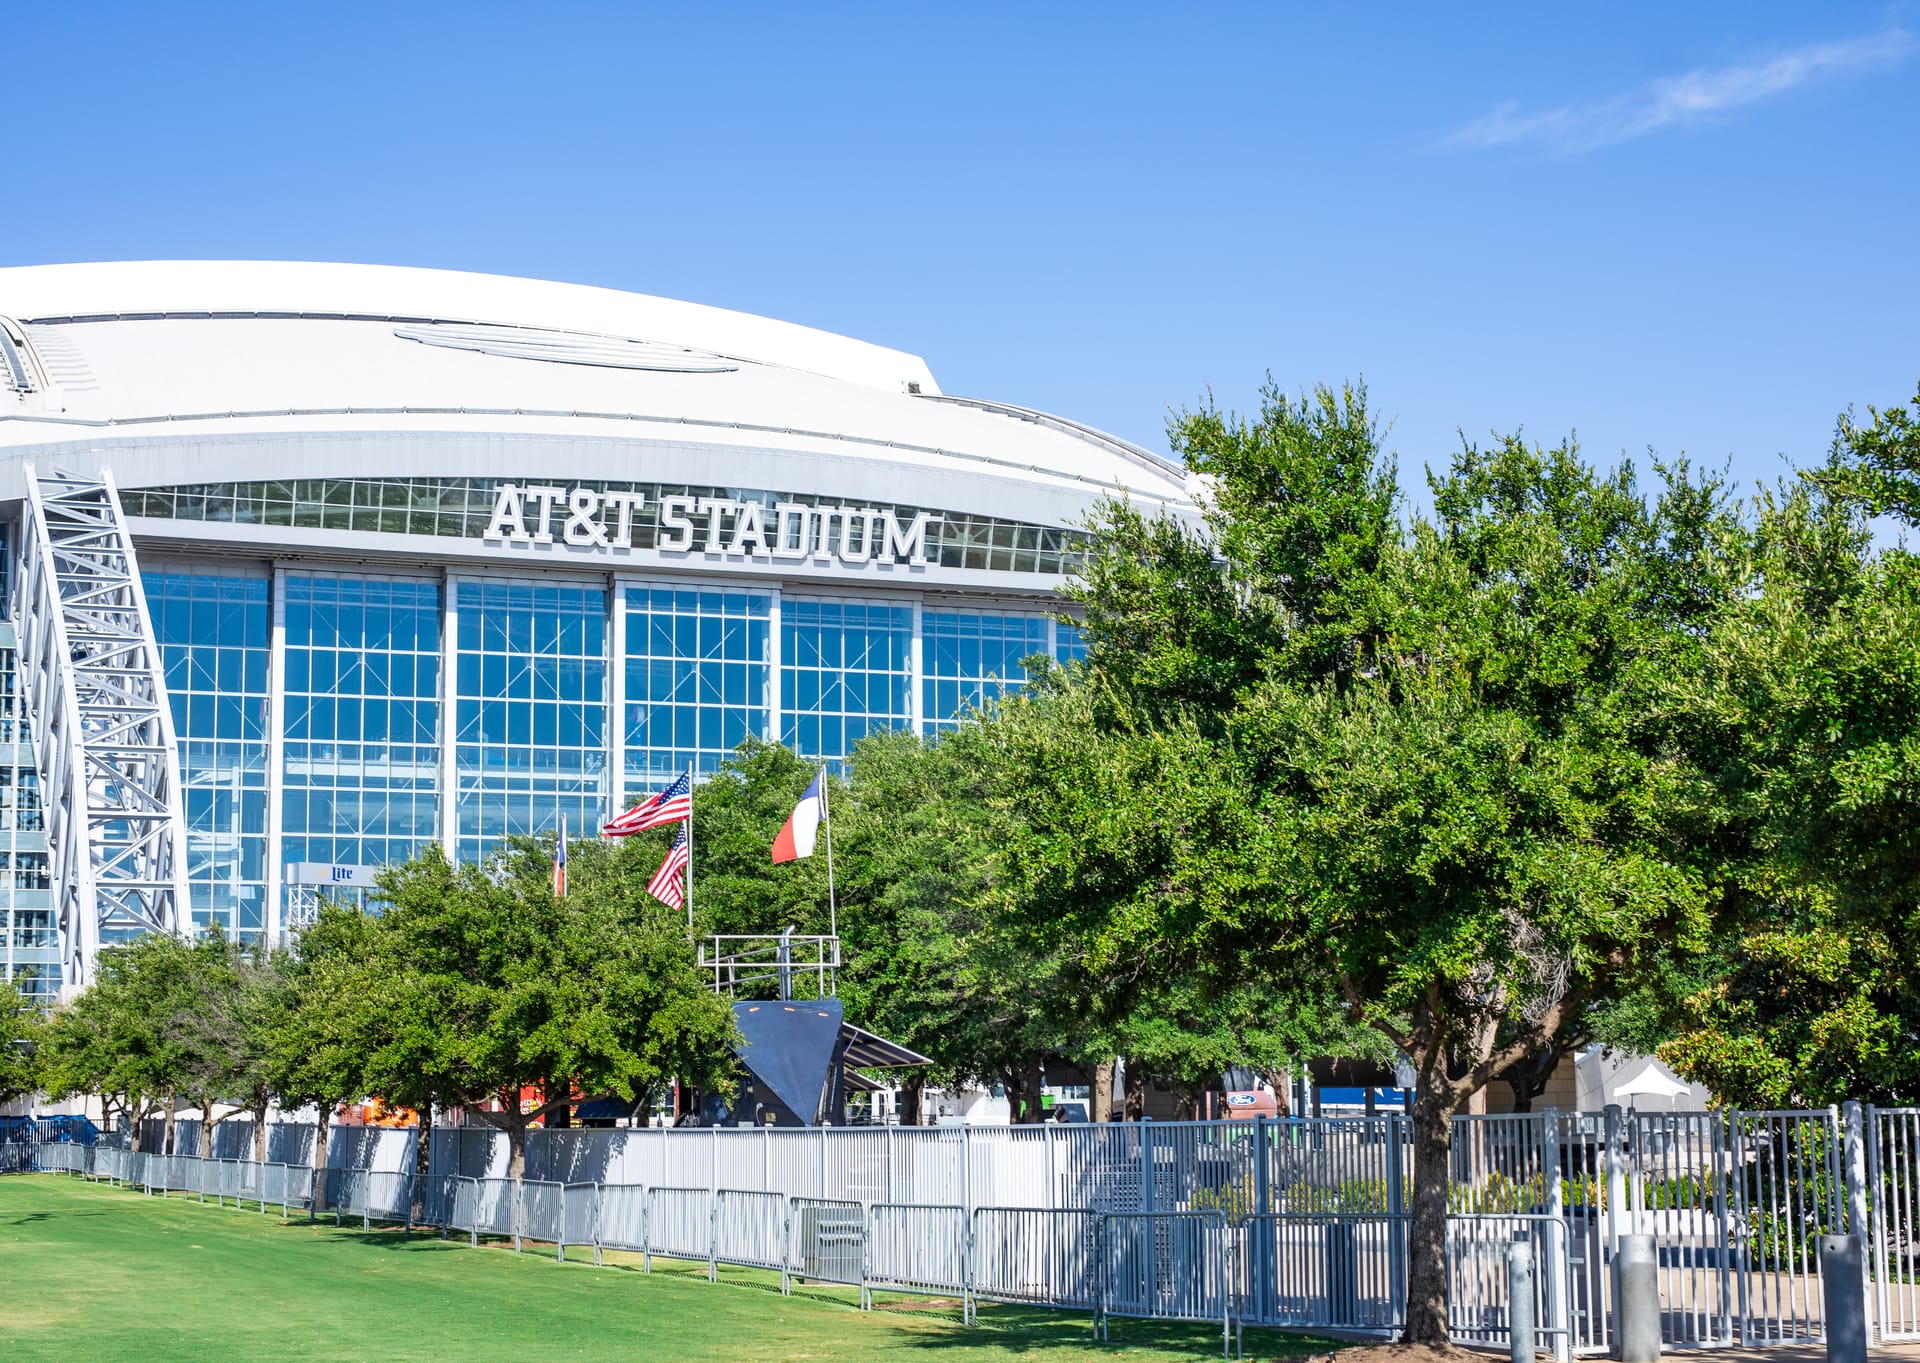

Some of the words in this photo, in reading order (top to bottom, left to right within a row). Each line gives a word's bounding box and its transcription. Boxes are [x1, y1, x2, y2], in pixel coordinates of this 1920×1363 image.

[483, 483, 645, 548] AT&T
[659, 494, 941, 566] STADIUM
[332, 866, 353, 881] Lite
